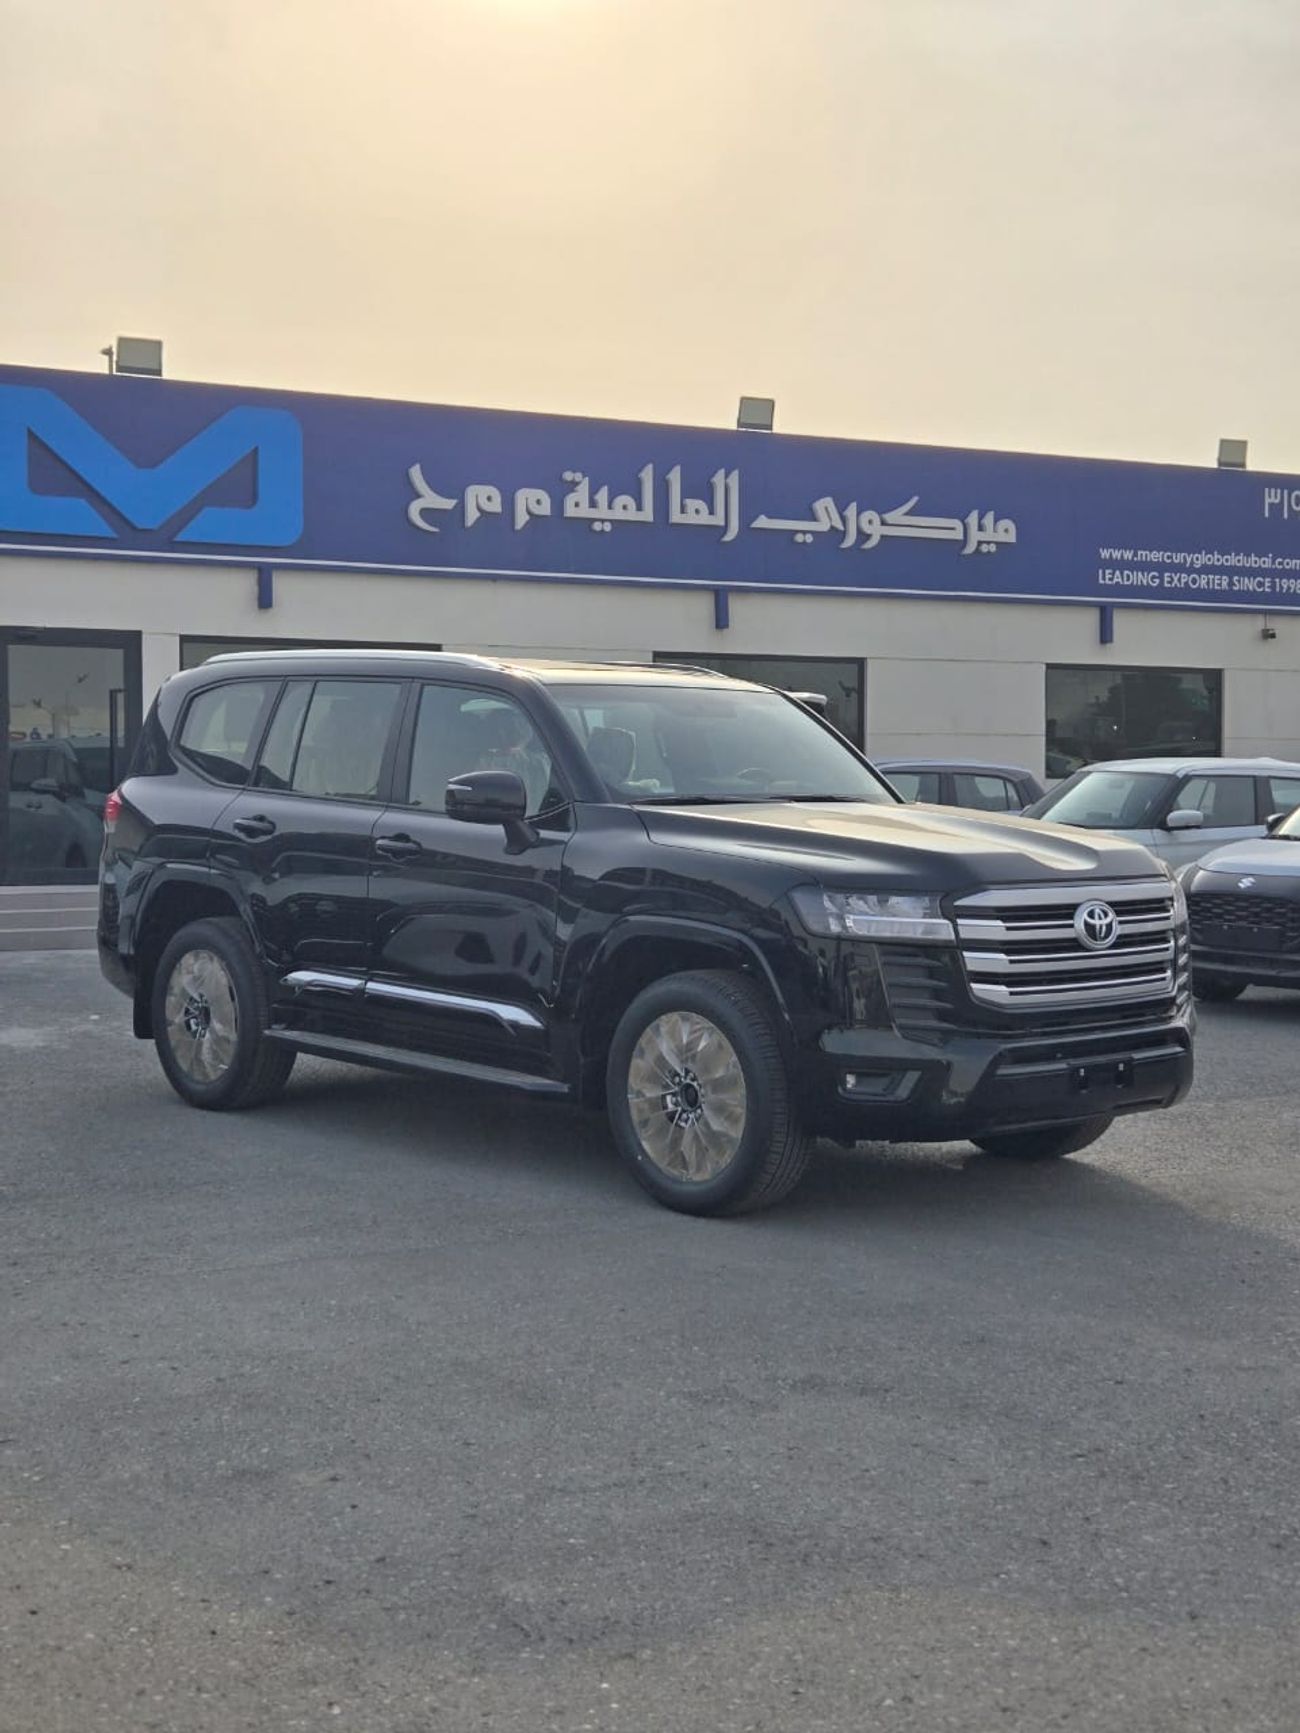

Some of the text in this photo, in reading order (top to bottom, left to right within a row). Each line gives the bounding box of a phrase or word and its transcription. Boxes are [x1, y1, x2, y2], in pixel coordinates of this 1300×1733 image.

[750, 495, 1017, 555] ميركوري
[1098, 569, 1160, 587] LEADING
[1164, 573, 1229, 591] EXPORTER
[1232, 575, 1272, 592] SINCE
